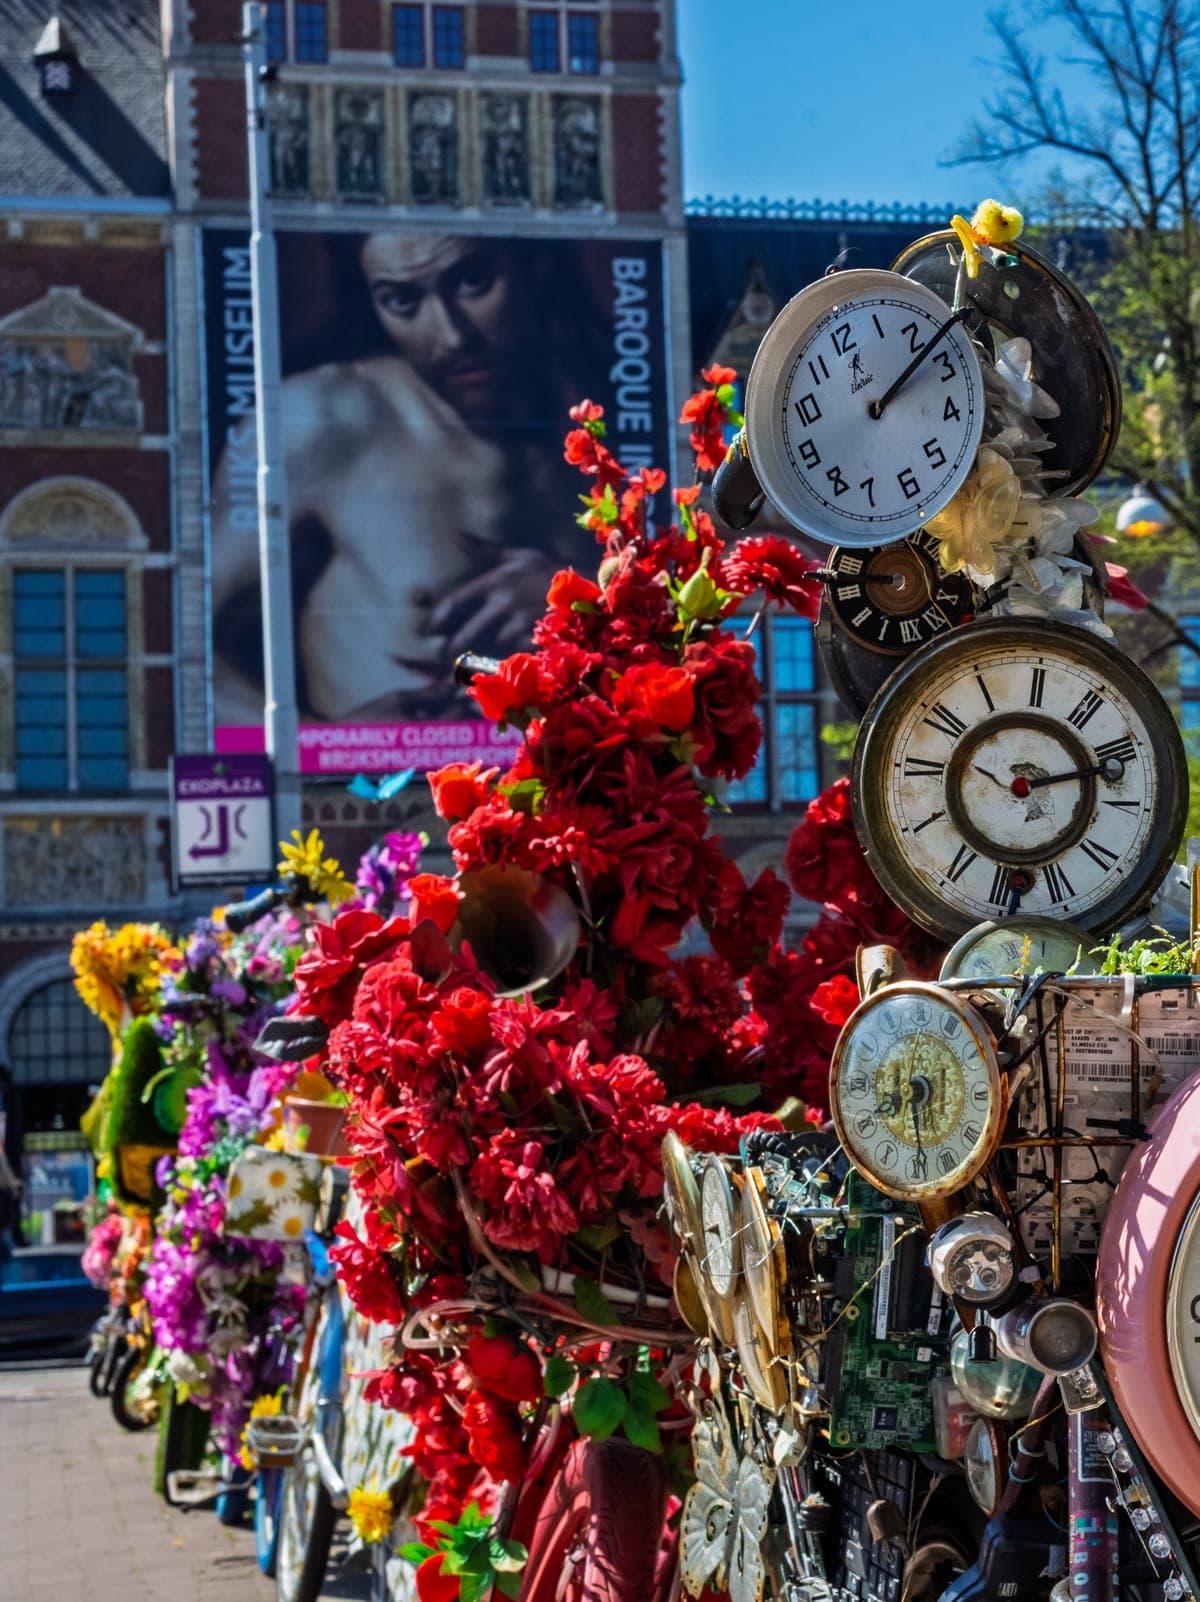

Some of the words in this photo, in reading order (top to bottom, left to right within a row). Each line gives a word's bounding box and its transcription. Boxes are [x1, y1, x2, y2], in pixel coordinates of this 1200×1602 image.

[830, 323, 857, 356] 12
[872, 314, 885, 339] 1
[901, 322, 926, 353] 2
[609, 257, 652, 433] BAROQUE
[808, 355, 830, 385] 11
[932, 351, 956, 382] 3
[850, 374, 874, 395] Electric
[795, 392, 822, 427] 10
[943, 396, 960, 422] 4
[798, 439, 821, 469] 9
[922, 438, 946, 469] 5
[826, 466, 850, 497] 8
[860, 477, 875, 507] 7
[897, 468, 921, 499] 6
[973, 673, 998, 713] I
[1029, 666, 1050, 709] II
[1063, 688, 1106, 733] III
[402, 725, 474, 747] CLOSED
[178, 776, 264, 794] EKOPLAZA
[1099, 799, 1141, 817] V
[1077, 837, 1120, 874] VI
[1042, 863, 1077, 905] VII
[1041, 940, 1047, 957] I
